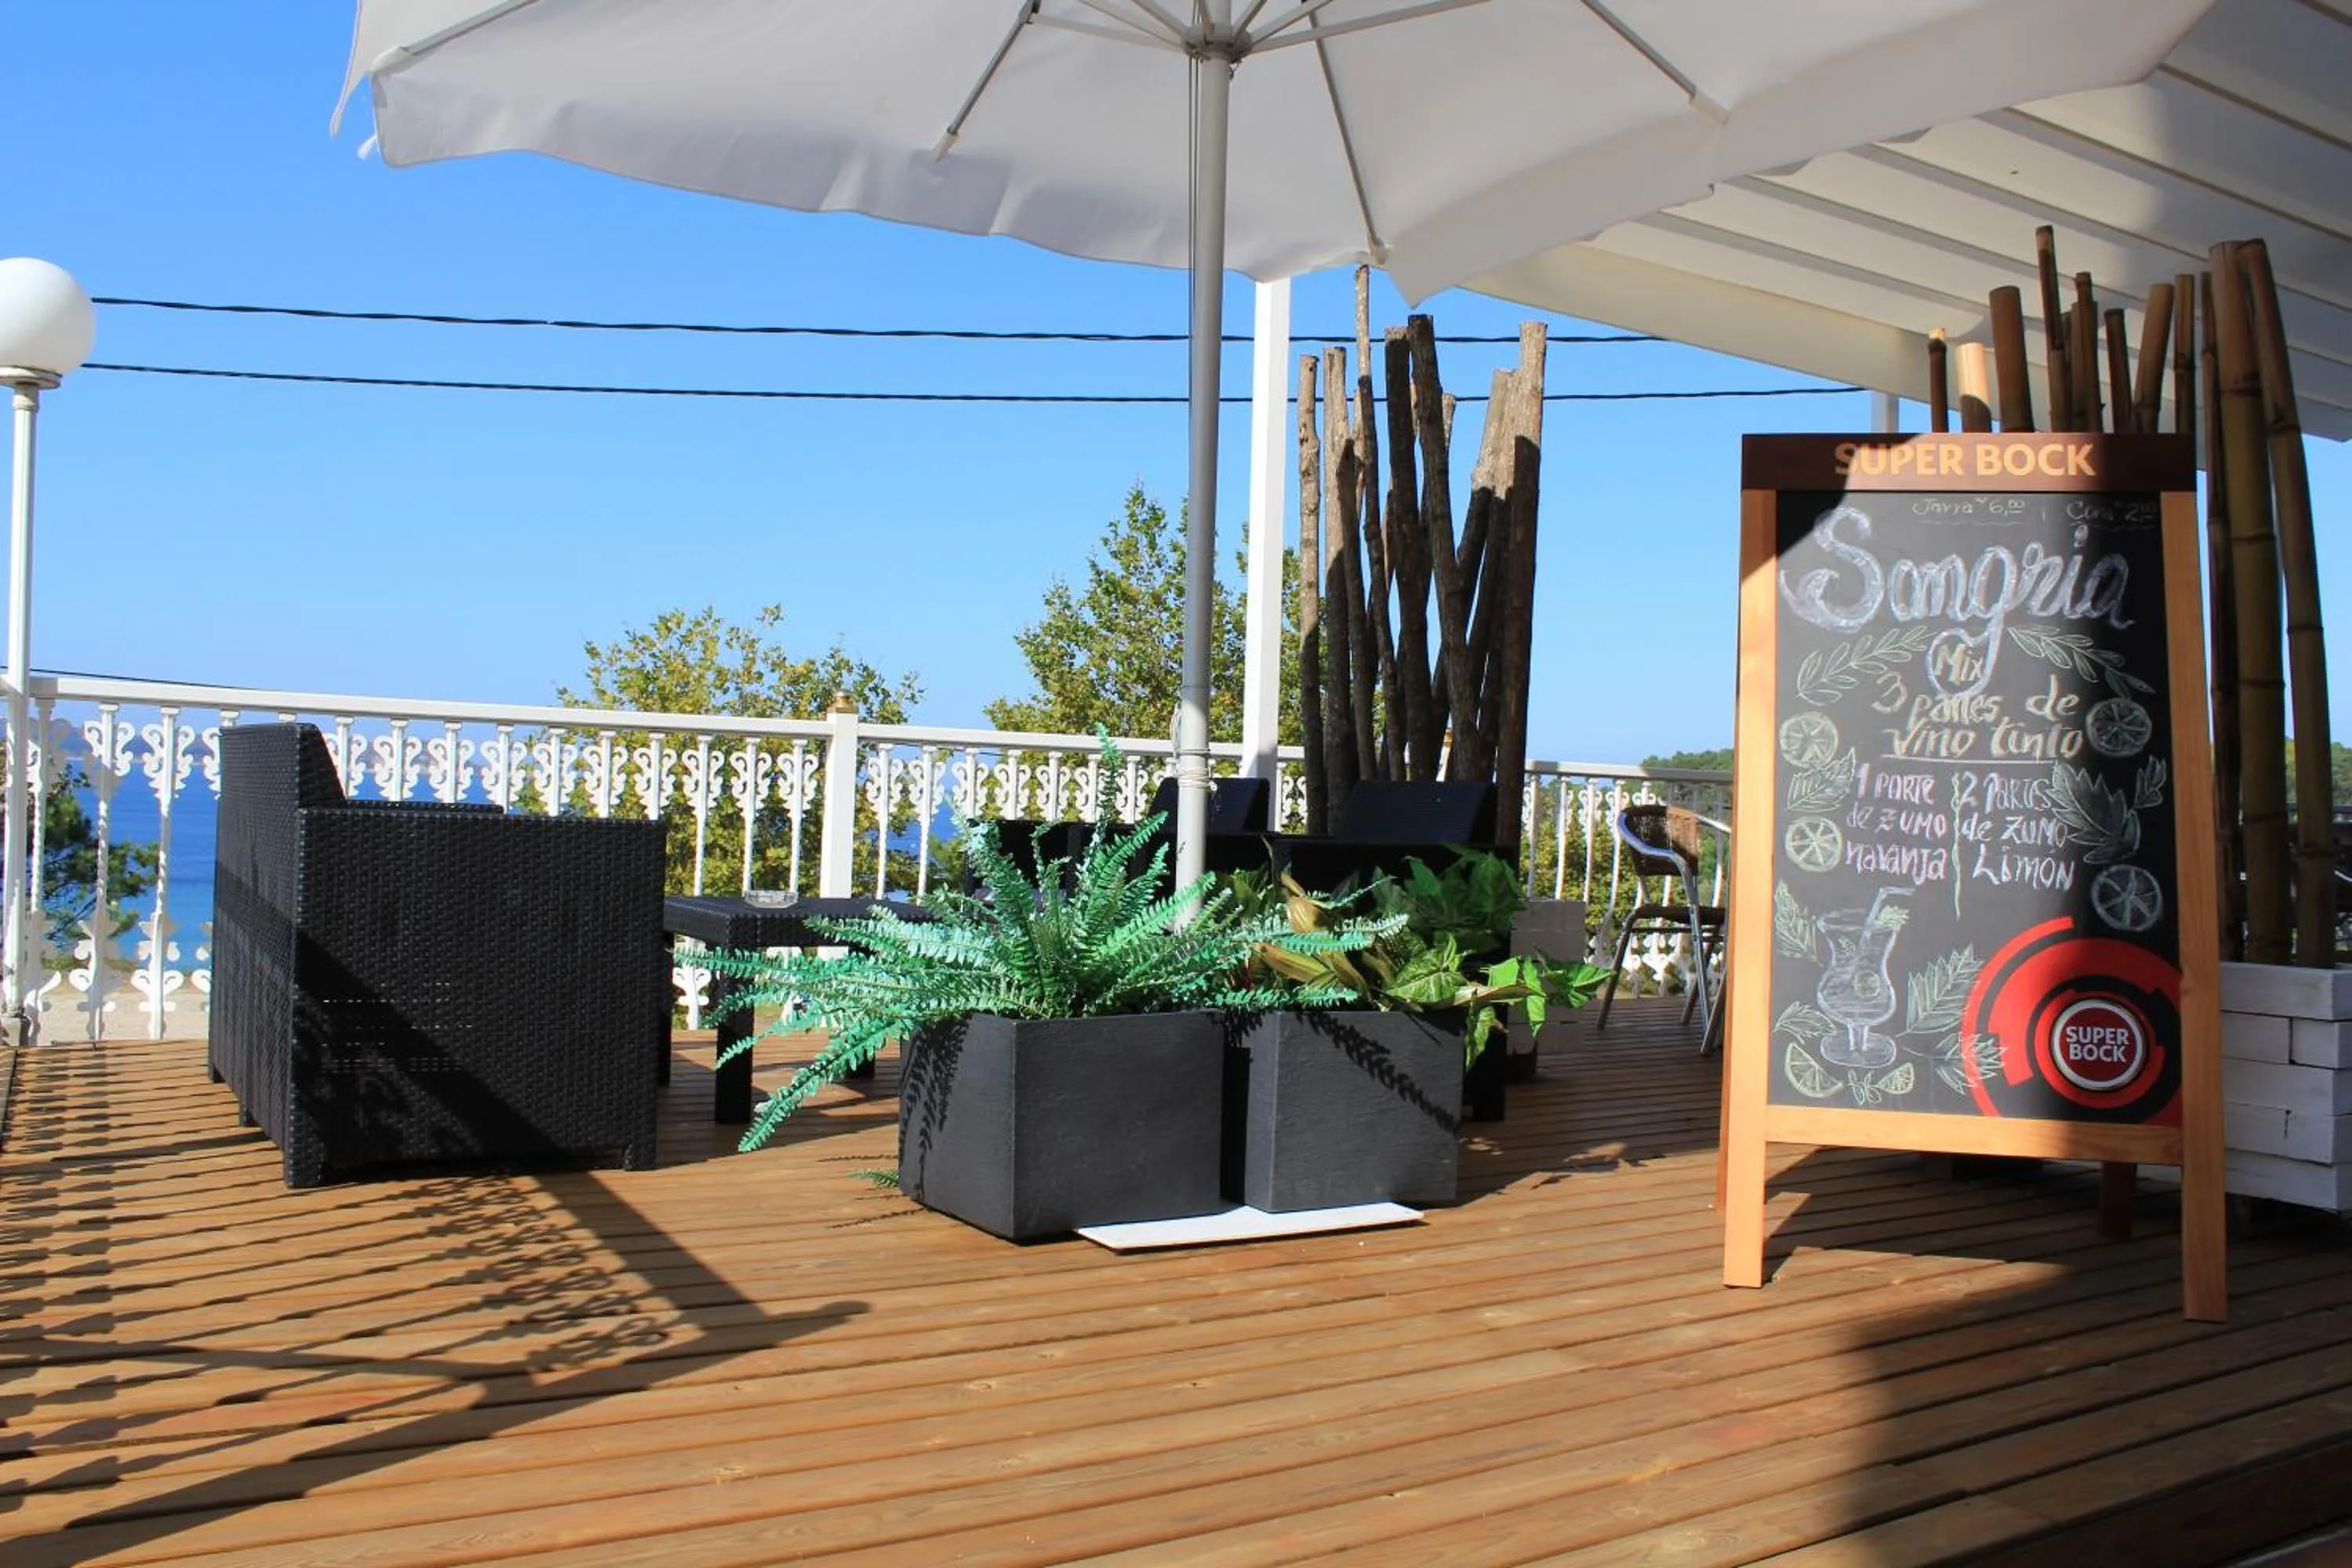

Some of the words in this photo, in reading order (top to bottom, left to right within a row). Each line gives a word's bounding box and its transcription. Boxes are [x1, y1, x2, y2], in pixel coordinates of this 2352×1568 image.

[1835, 443, 1966, 476] SUPER
[1976, 443, 2096, 476] BOCK
[1933, 642, 1984, 686] Mix
[1871, 670, 1908, 714] 3
[2024, 673, 2081, 721] de
[1856, 762, 1871, 799] 1
[1959, 770, 1978, 808] 2
[1846, 801, 1874, 829] de
[1961, 811, 1994, 842] de
[2066, 1025, 2129, 1045] SUPER
[2069, 1044, 2127, 1063] BOCK
